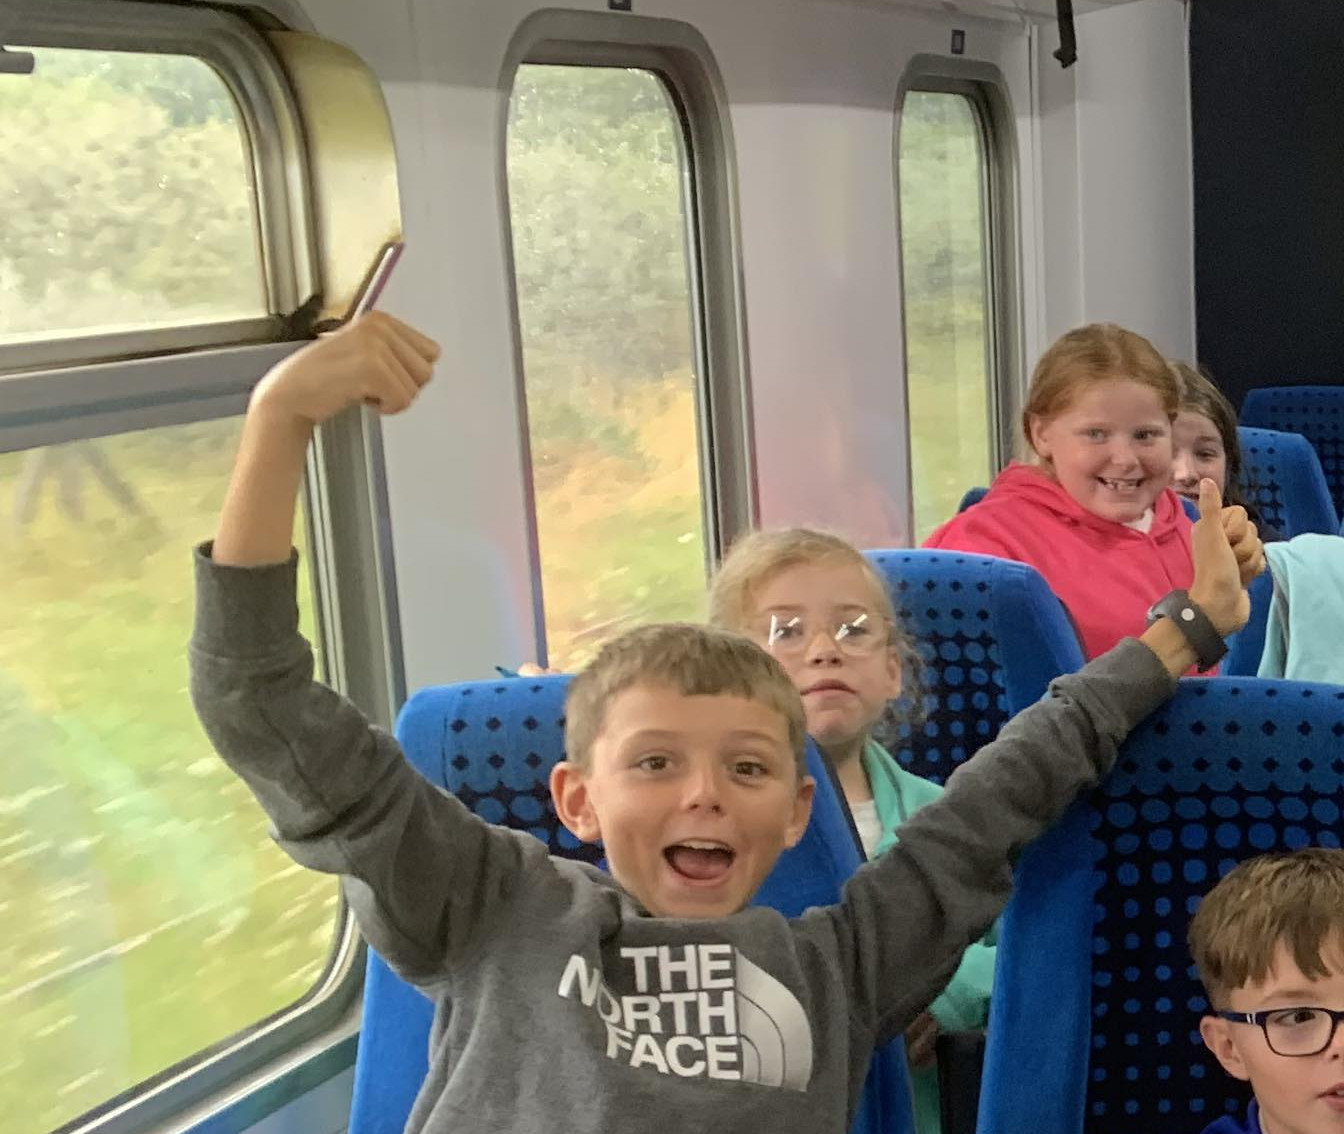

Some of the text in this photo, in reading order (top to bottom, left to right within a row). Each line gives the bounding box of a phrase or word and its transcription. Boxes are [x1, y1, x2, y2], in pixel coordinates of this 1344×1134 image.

[558, 953, 737, 1036] NORTH
[620, 943, 736, 993] THE
[604, 1018, 742, 1081] FACE
